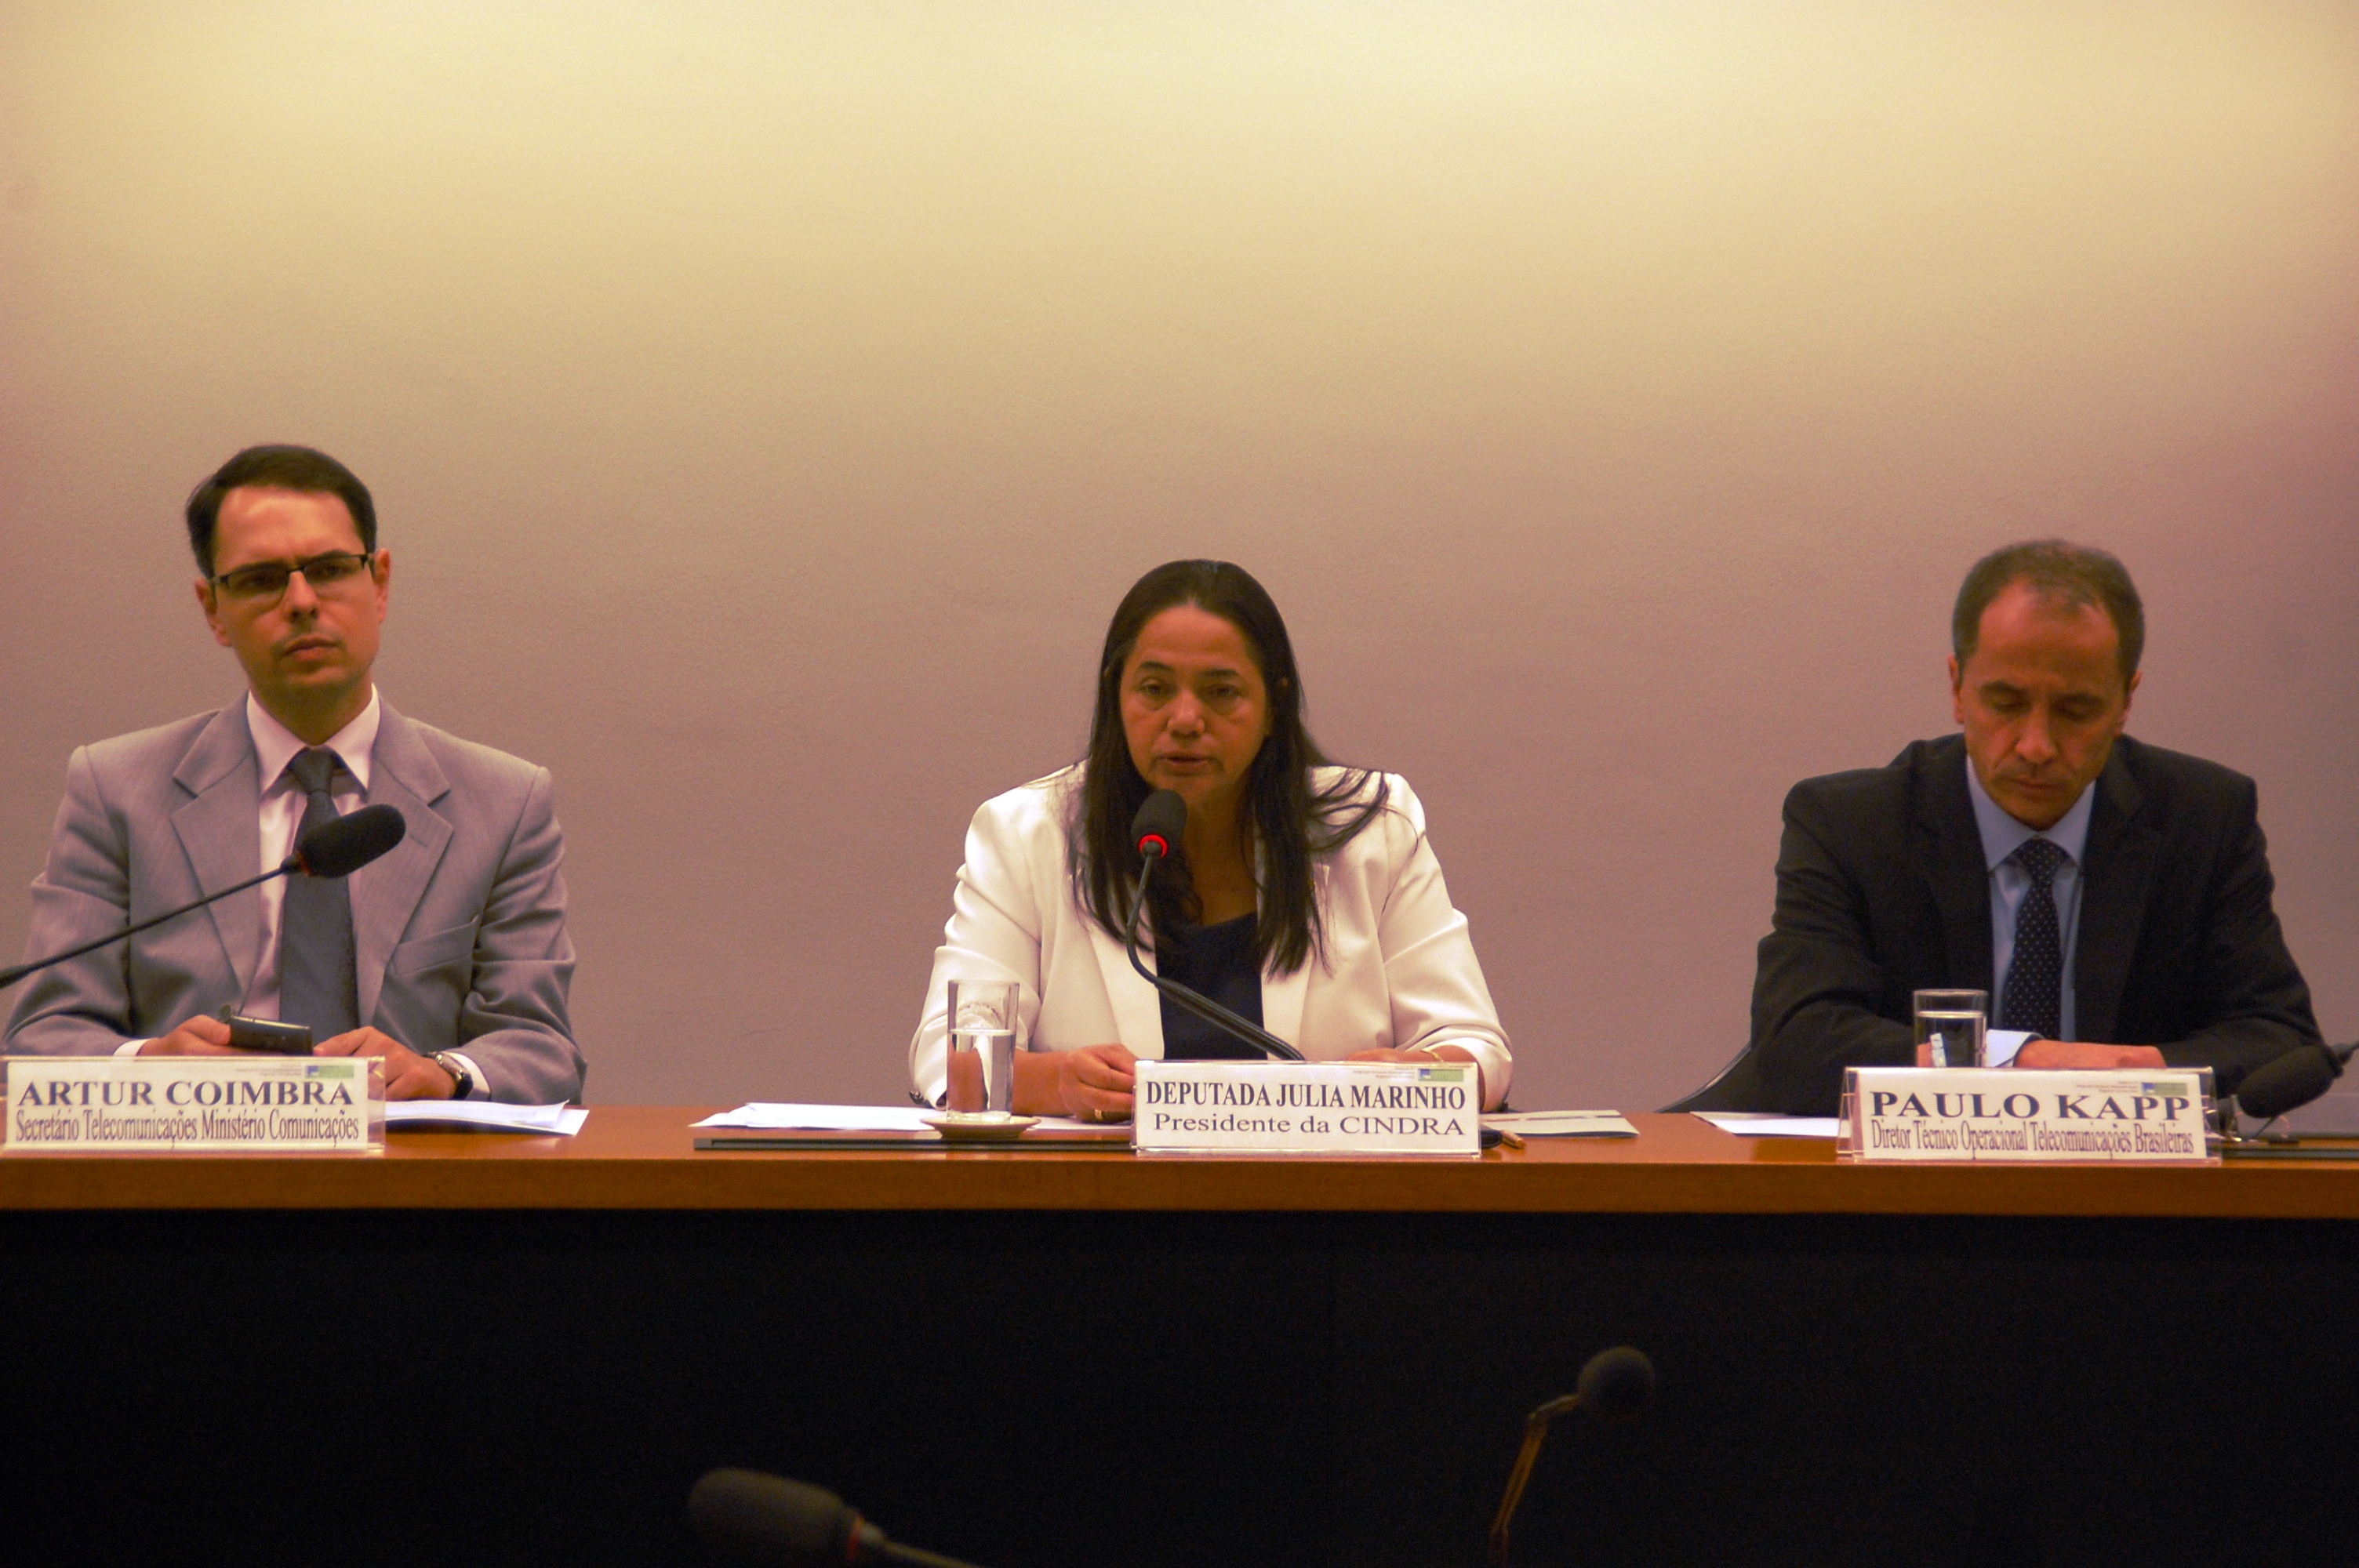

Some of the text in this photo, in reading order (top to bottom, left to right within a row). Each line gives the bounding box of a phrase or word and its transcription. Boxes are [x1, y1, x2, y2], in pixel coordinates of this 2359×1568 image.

[17, 1080, 354, 1106] ARTUR COIMBRA
[1146, 1081, 1466, 1110] DEPUTADA JULIA MARINHO
[1870, 1091, 2190, 1120] PAULO KAPP
[16, 1108, 358, 1148] Secretário Telecomunicações Ministério Comunicações
[1153, 1113, 1465, 1136] Presidente da CINDRA
[1871, 1118, 2194, 1160] Diretor Técnico Operacional Telecomunicações Brasileiras
